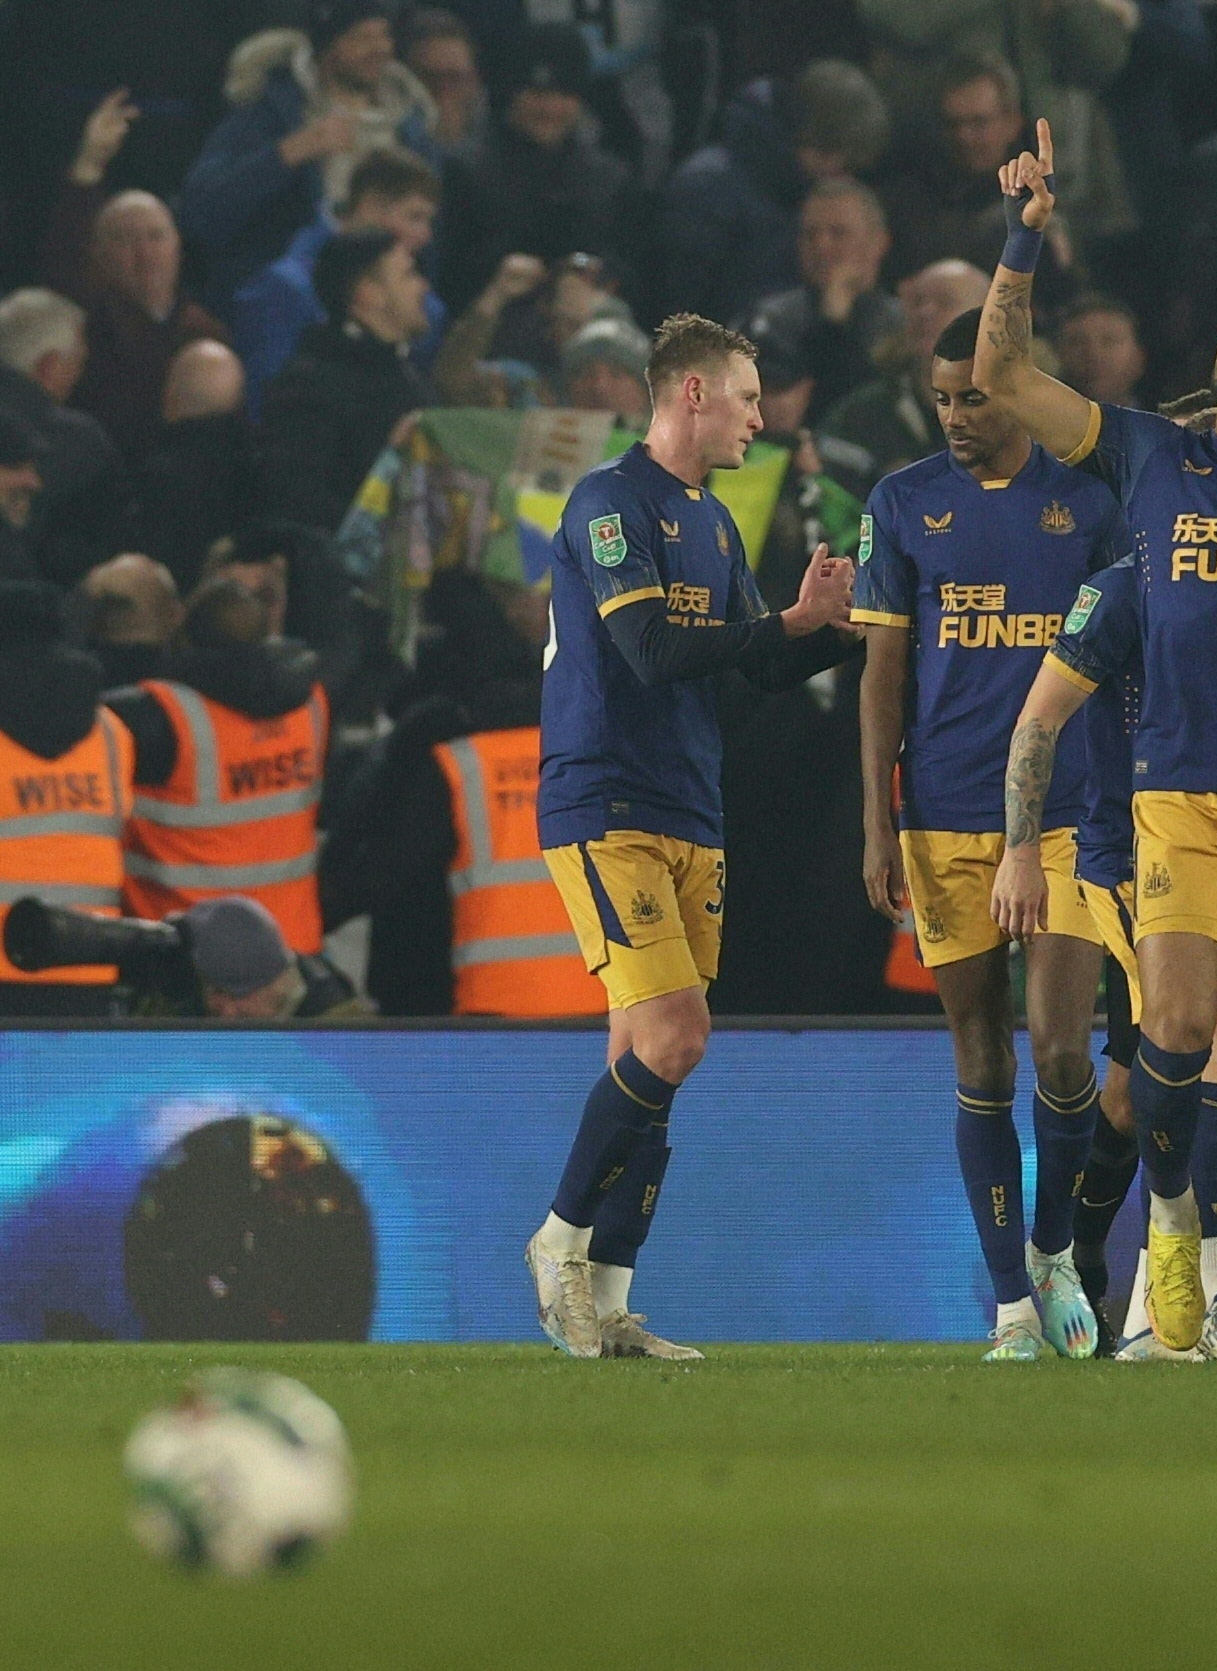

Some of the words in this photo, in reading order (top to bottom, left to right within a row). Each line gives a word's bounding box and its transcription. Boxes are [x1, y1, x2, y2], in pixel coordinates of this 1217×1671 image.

[939, 581, 1006, 612] 乐天堂
[937, 614, 1063, 648] FUN88
[228, 748, 315, 795] WISE
[12, 773, 102, 809] WISE
[991, 1185, 1008, 1227] NUFC
